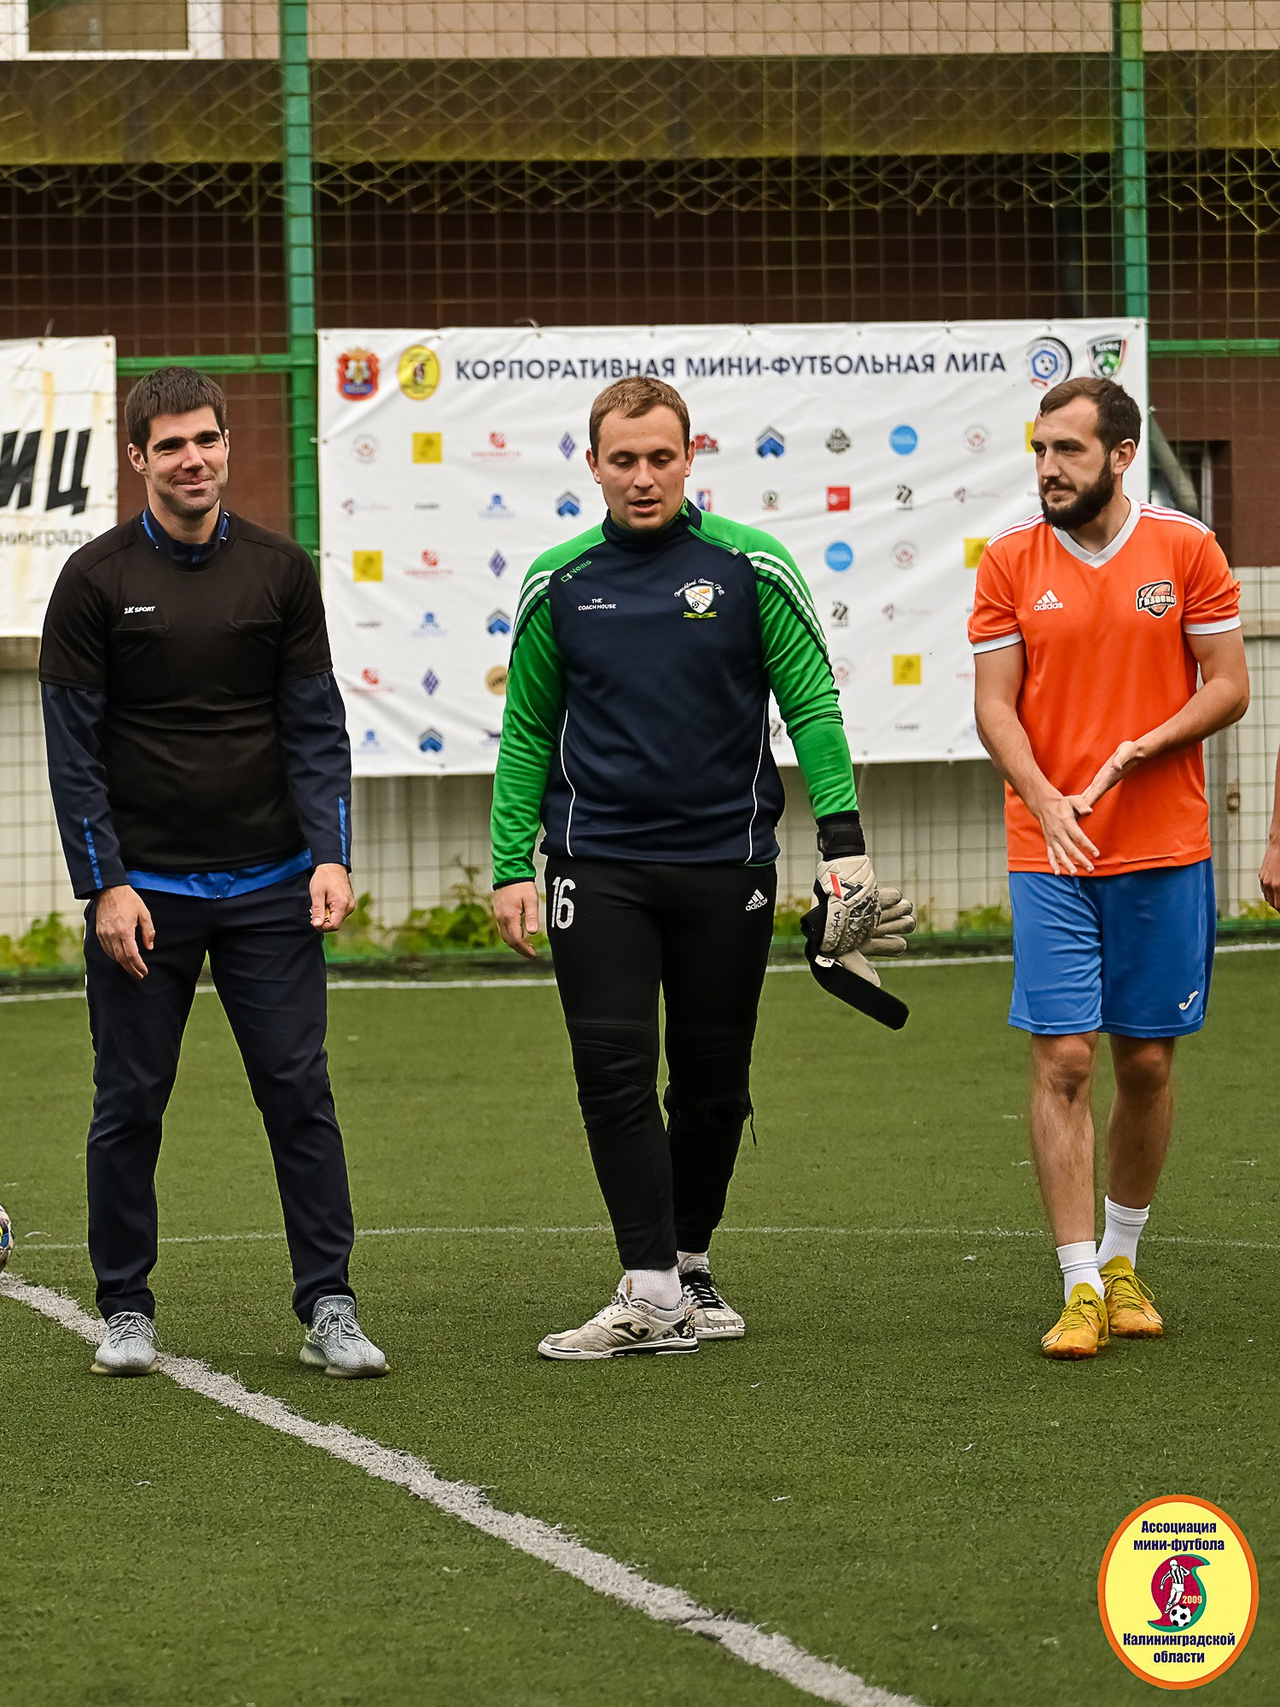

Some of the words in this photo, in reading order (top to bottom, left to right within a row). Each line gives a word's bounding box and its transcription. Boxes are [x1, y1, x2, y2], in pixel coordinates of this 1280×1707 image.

[455, 358, 675, 380] КОРПОРАТИВНАЯ
[686, 353, 935, 378] МИНИ-ФУТБОЛЬНАЯ
[945, 352, 1007, 374] ЛИГА
[134, 605, 156, 613] SPORT
[1033, 601, 1064, 612] adidas
[551, 876, 577, 930] 16
